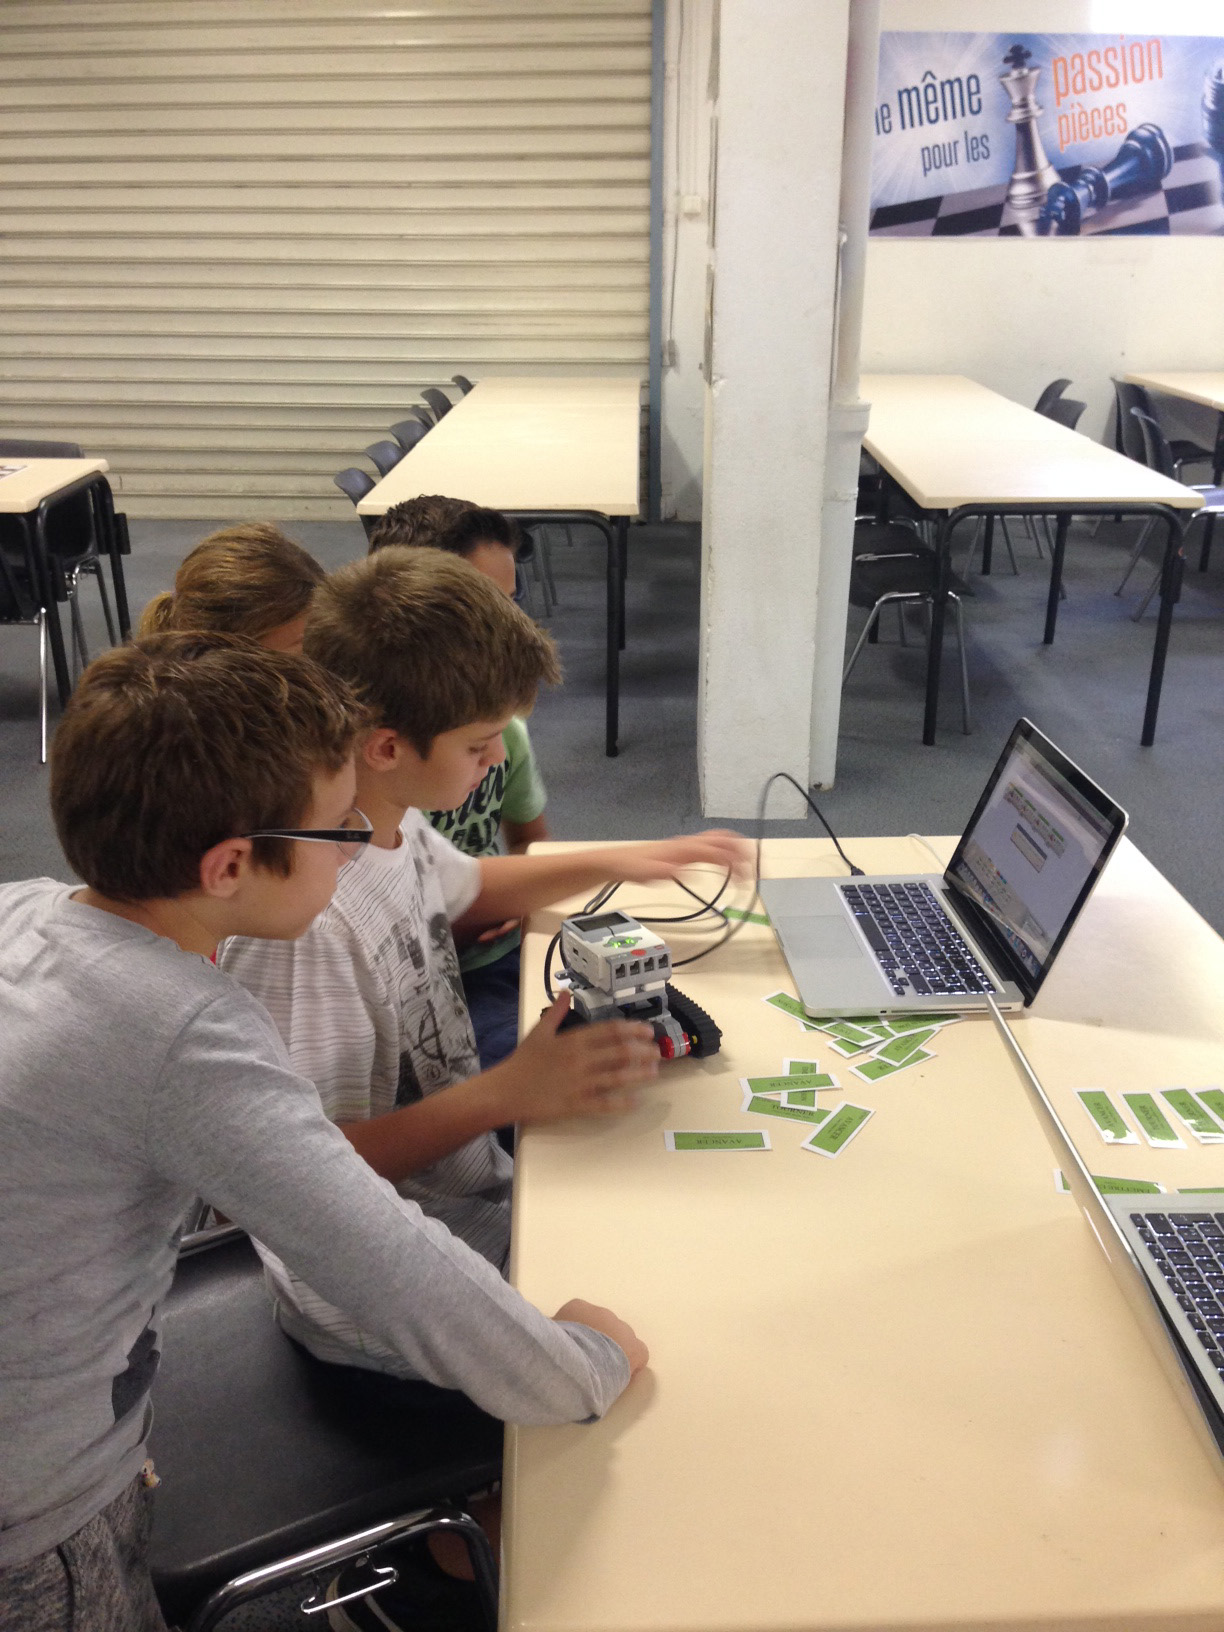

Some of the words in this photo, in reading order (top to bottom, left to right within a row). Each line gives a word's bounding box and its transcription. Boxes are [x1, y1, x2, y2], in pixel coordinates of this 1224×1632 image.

[897, 70, 982, 130] même
[1052, 35, 1163, 107] passion
[921, 140, 959, 177] pour
[964, 130, 990, 163] les
[1058, 102, 1128, 153] pièces
